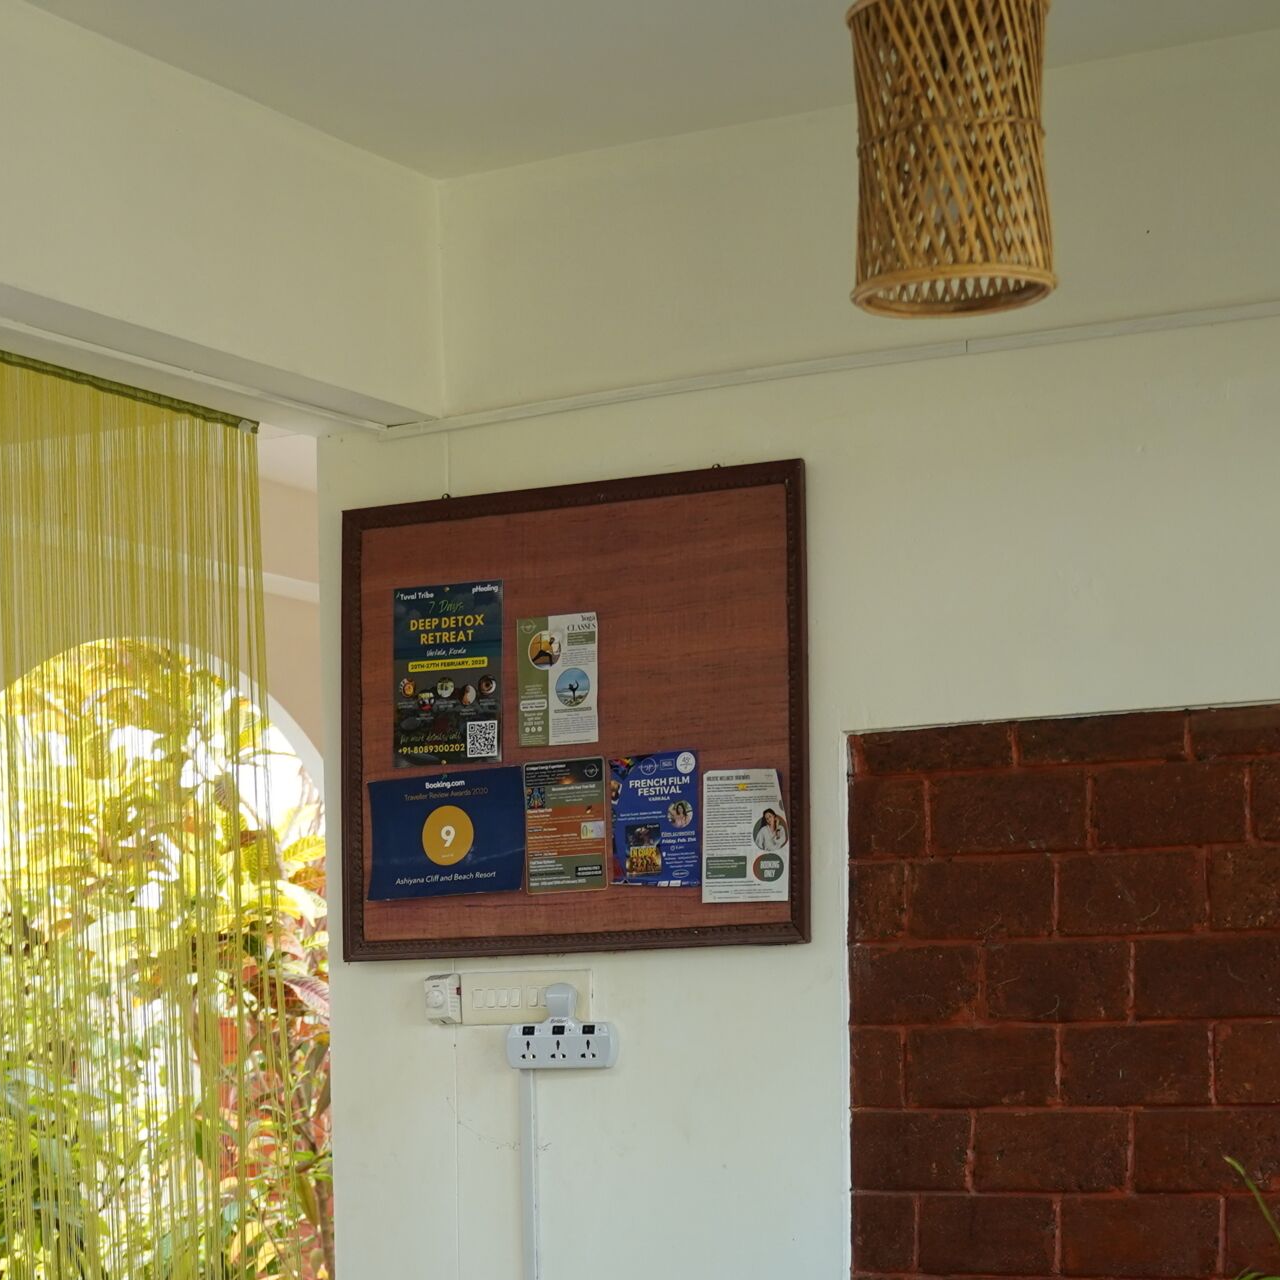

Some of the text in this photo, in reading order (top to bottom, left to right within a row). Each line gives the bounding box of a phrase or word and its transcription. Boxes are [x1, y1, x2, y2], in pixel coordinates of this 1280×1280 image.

[418, 591, 434, 599] Tribe
[429, 599, 464, 614] 7 Days
[410, 614, 484, 631] DEEP DETOX
[567, 623, 596, 631] CLASSES
[420, 630, 474, 645] RETREAT
[440, 660, 471, 668] FEBRUARY,
[398, 744, 466, 755] +91-8089300202
[425, 780, 465, 789] Booking.com
[629, 776, 690, 789] FRENCH FILM
[404, 787, 488, 801] Traveller Review Awards 2020
[638, 785, 682, 796] FESTIVAL
[440, 825, 456, 847] 9
[760, 860, 780, 869] BOOKING
[395, 871, 496, 887] Ashiyana Cliff and Beach Resort
[764, 870, 775, 878] ONLY
